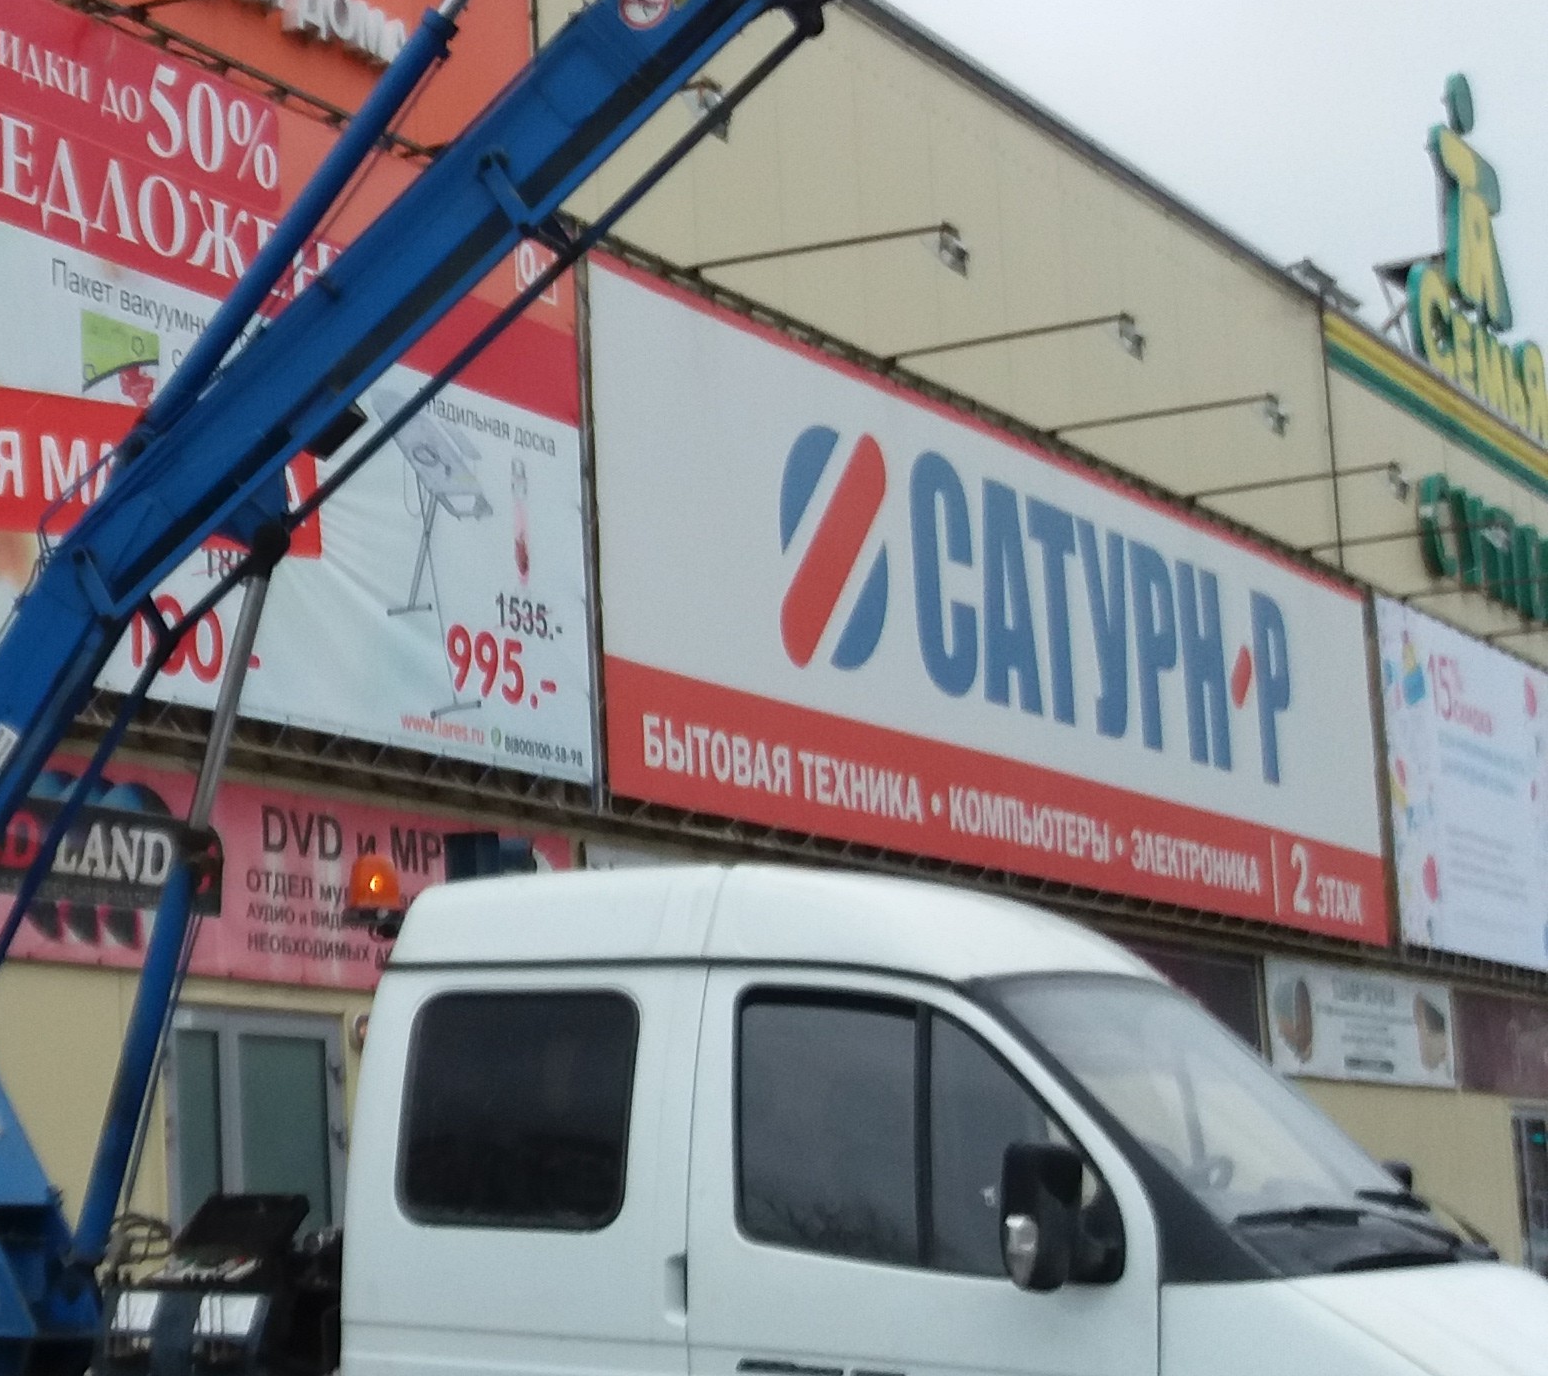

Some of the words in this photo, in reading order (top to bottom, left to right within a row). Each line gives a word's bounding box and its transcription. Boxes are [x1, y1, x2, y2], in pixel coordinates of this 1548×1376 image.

[148, 65, 279, 191] 50%
[52, 258, 114, 305] Пакет
[422, 388, 510, 440] ладильная
[514, 426, 557, 457] доска
[261, 804, 344, 861] DVD
[389, 825, 443, 875] MP
[642, 713, 792, 797] БЫТОВАЯ
[798, 750, 923, 824] ТЕХНИКА
[949, 784, 1111, 865] КОМПЬЮТЕРЫ
[1130, 829, 1261, 896] ЭЛЕКТРОНИКА
[1291, 846, 1311, 916] 2
[1314, 875, 1363, 925] ЭТАЖ
[246, 867, 314, 901] ОТДЕЛ
